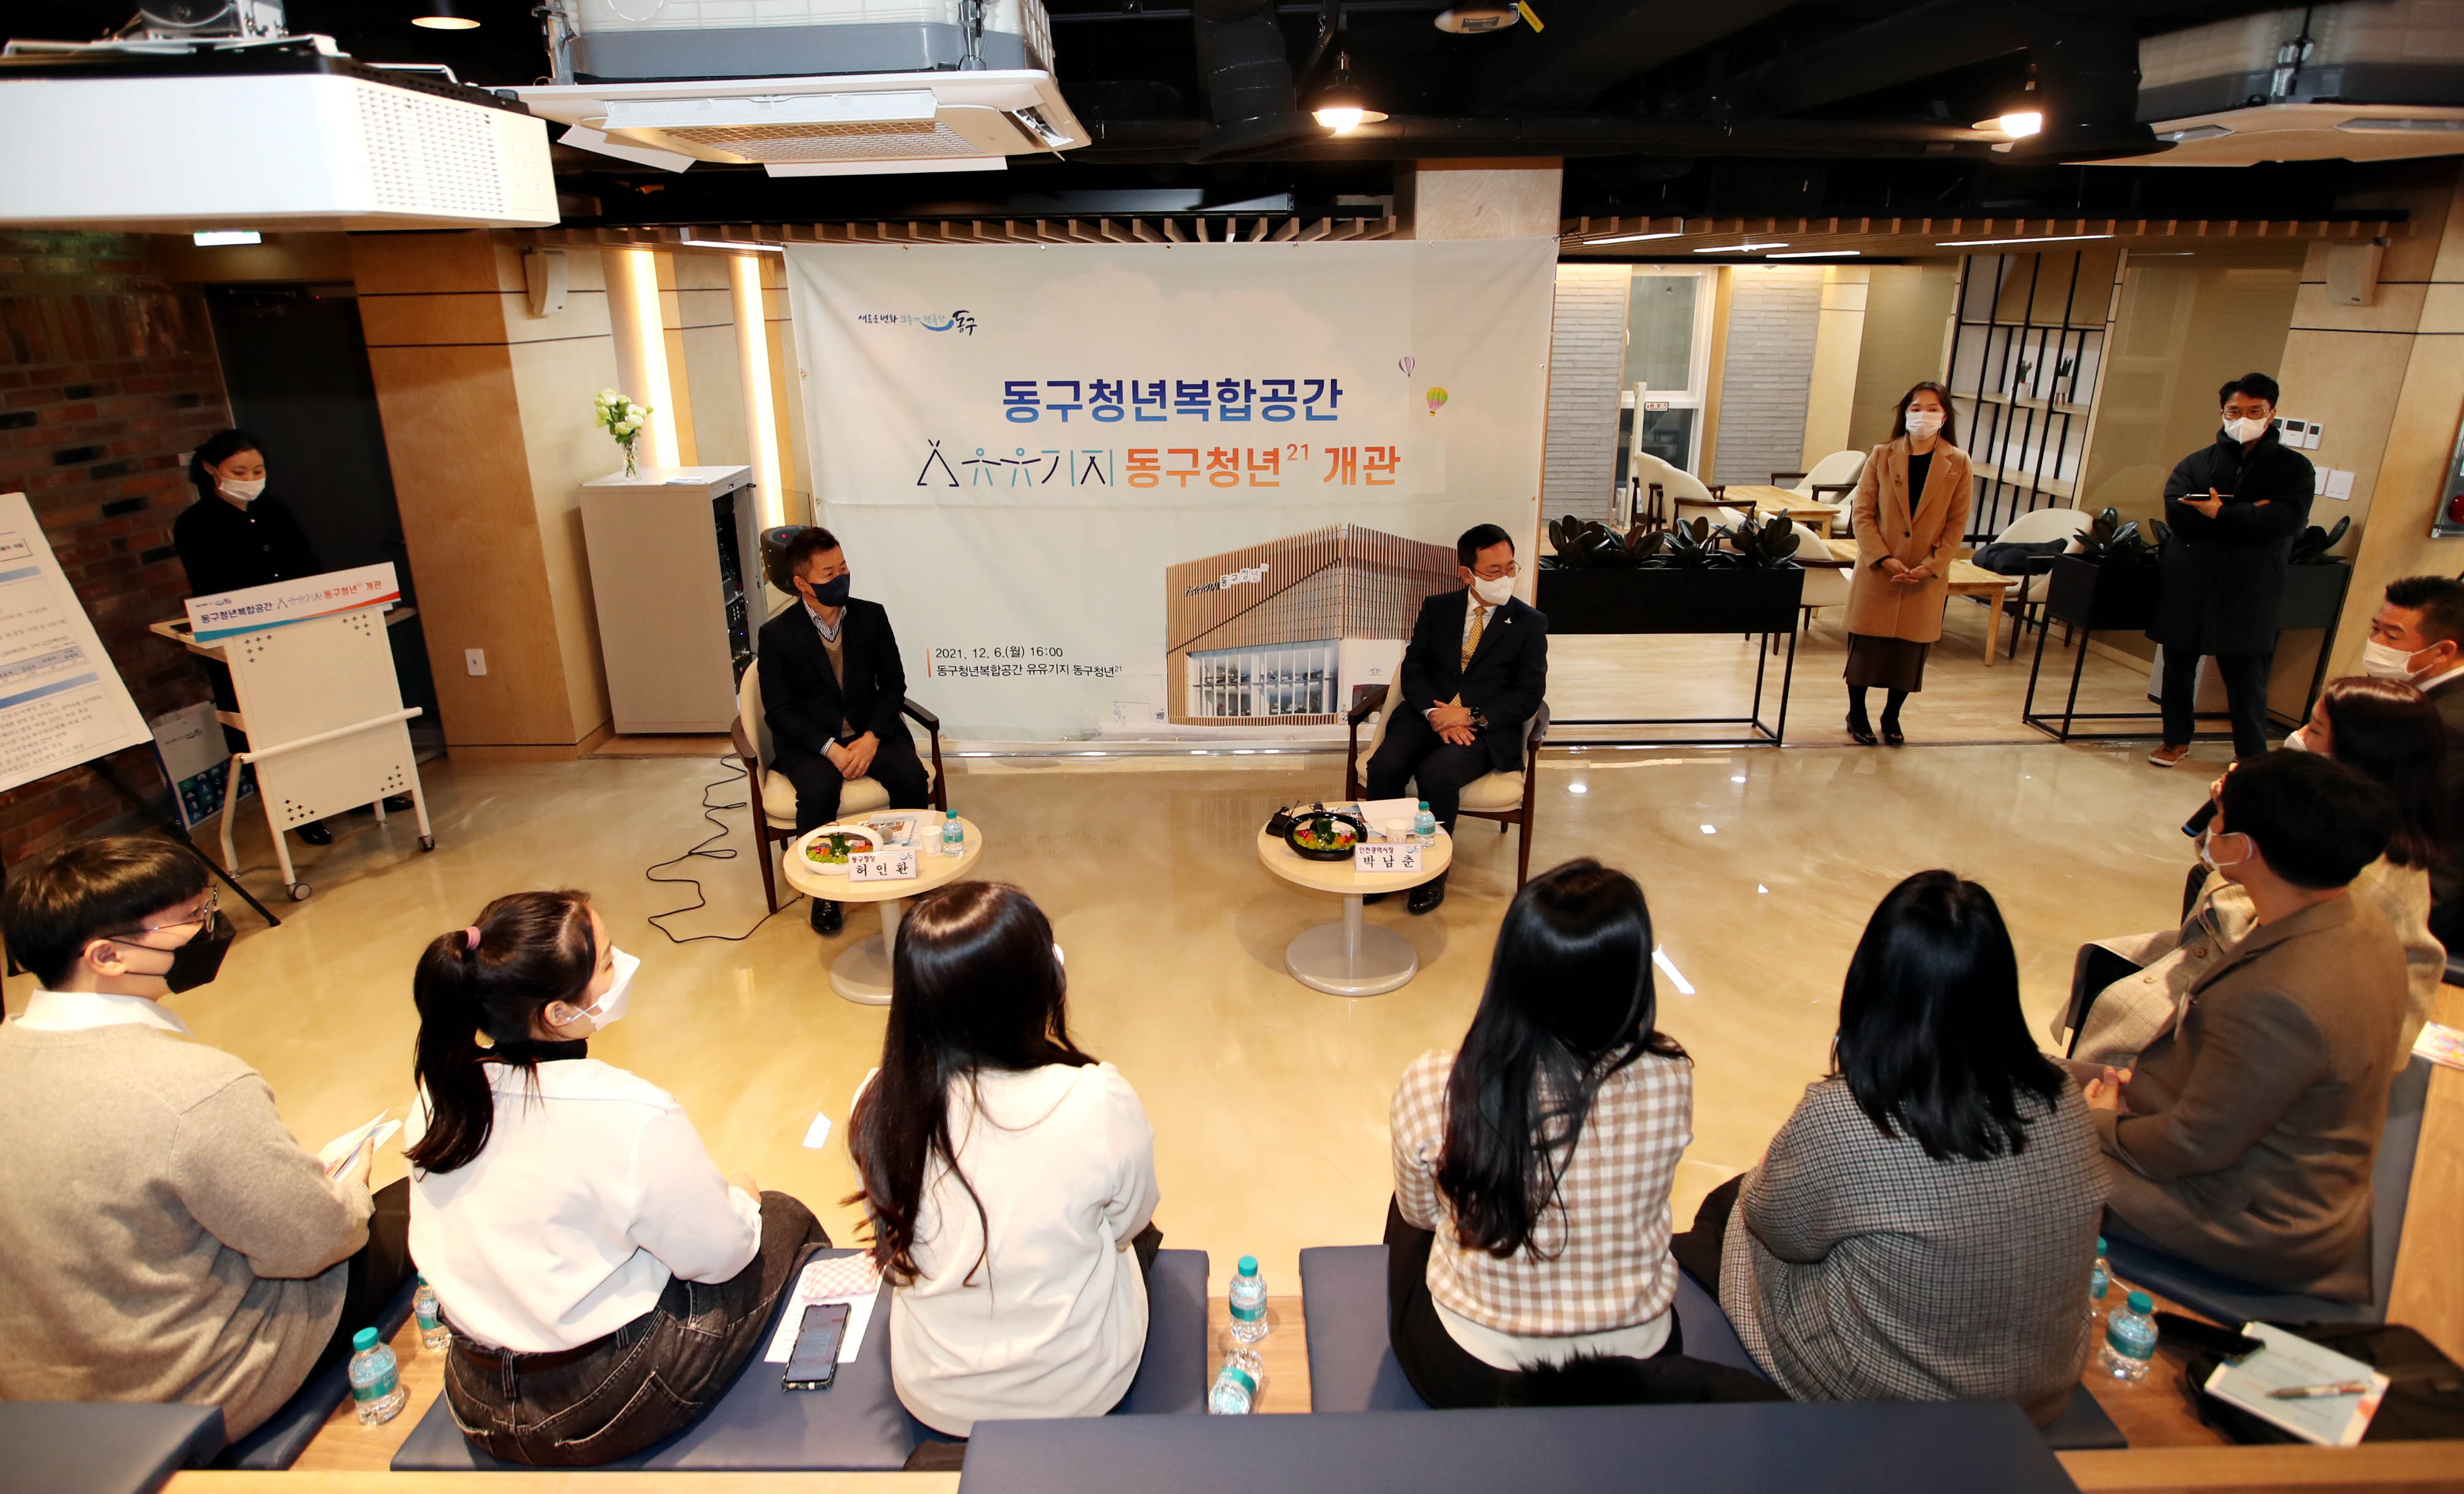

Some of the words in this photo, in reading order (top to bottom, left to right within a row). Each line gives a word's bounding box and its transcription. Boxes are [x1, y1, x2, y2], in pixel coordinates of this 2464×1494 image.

[953, 310, 978, 335] 동구
[1002, 378, 1343, 423] 동구청년복합공간
[1323, 445, 1401, 488] 개관
[201, 602, 272, 624] 동구청년복합공간
[935, 648, 967, 659] 2021.
[973, 647, 989, 659] 12.
[994, 646, 1025, 659] 6.(월)
[1031, 647, 1063, 657] 16:00
[937, 664, 1023, 678] 동구청년복합공간
[1026, 664, 1069, 675] 유유기지
